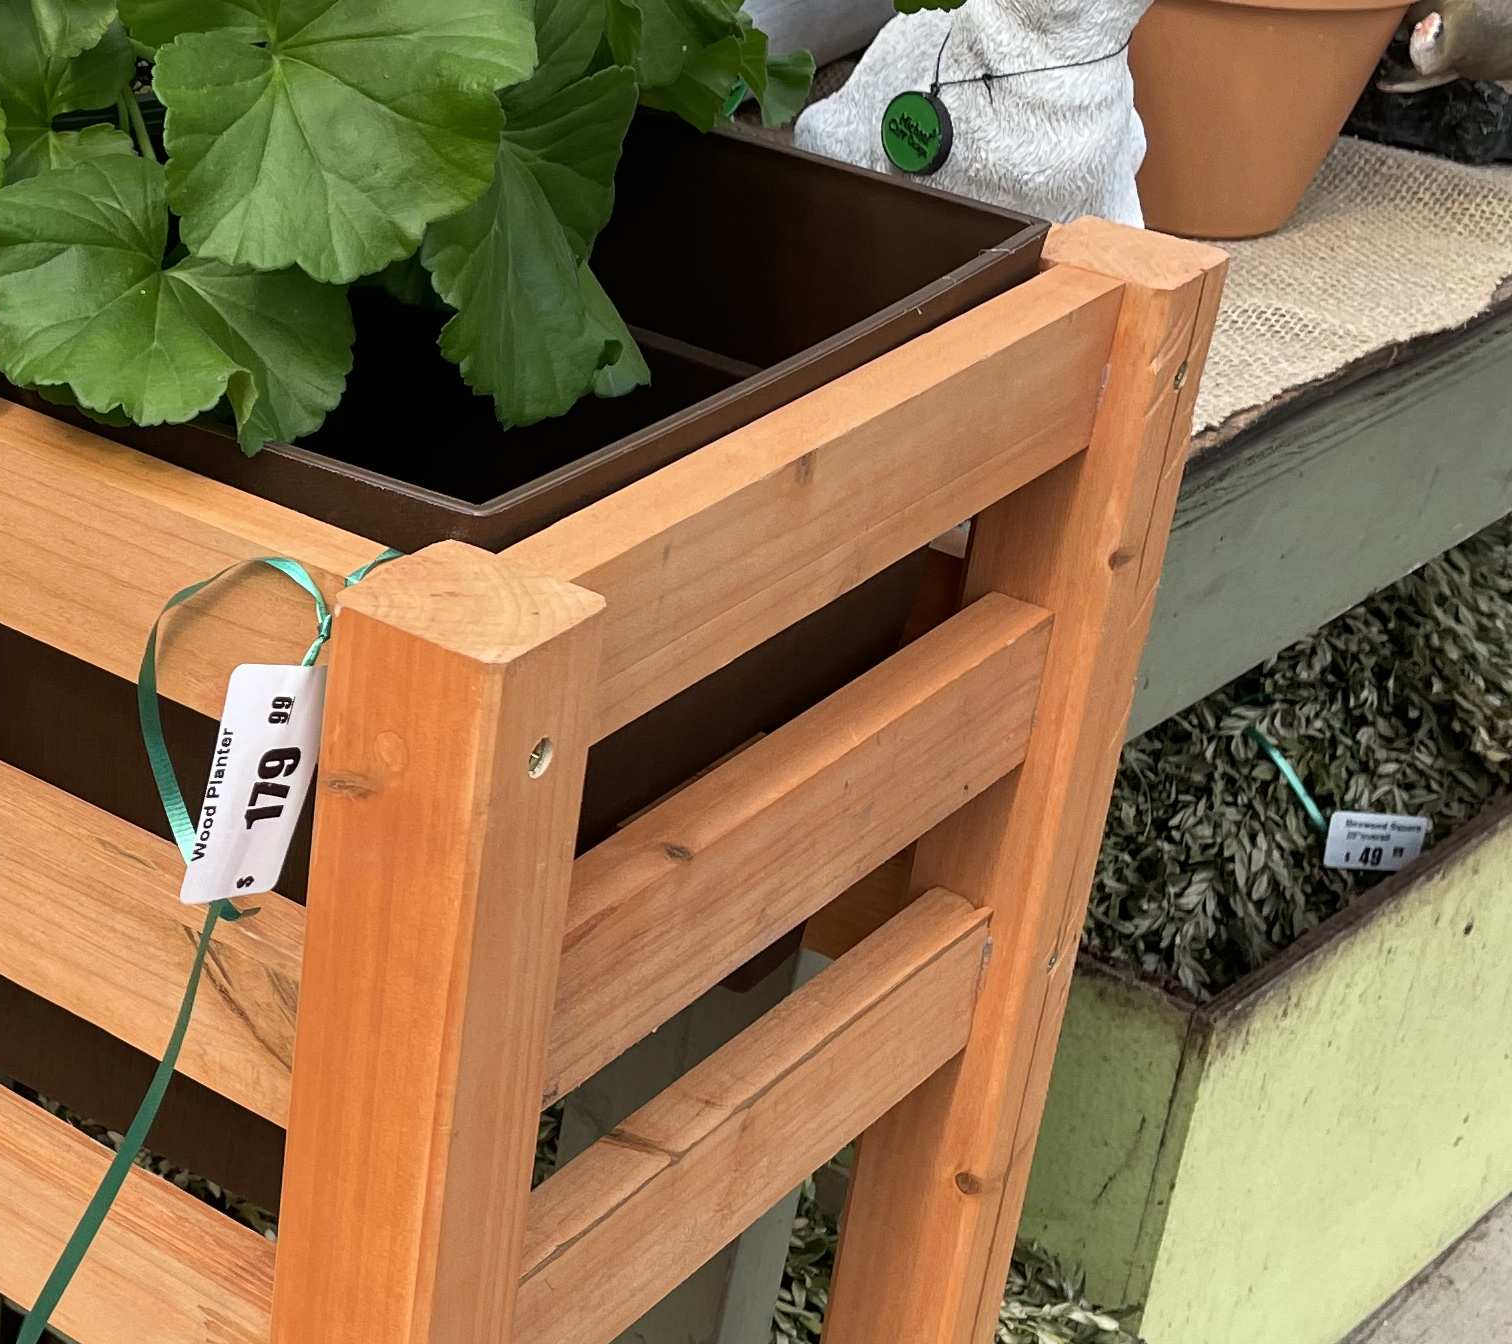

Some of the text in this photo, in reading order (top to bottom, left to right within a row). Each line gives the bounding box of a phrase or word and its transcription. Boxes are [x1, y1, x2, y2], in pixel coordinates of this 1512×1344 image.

[191, 728, 234, 862] Wood Planter
[236, 696, 302, 889] $ 179 99
[1358, 846, 1383, 866] 49
